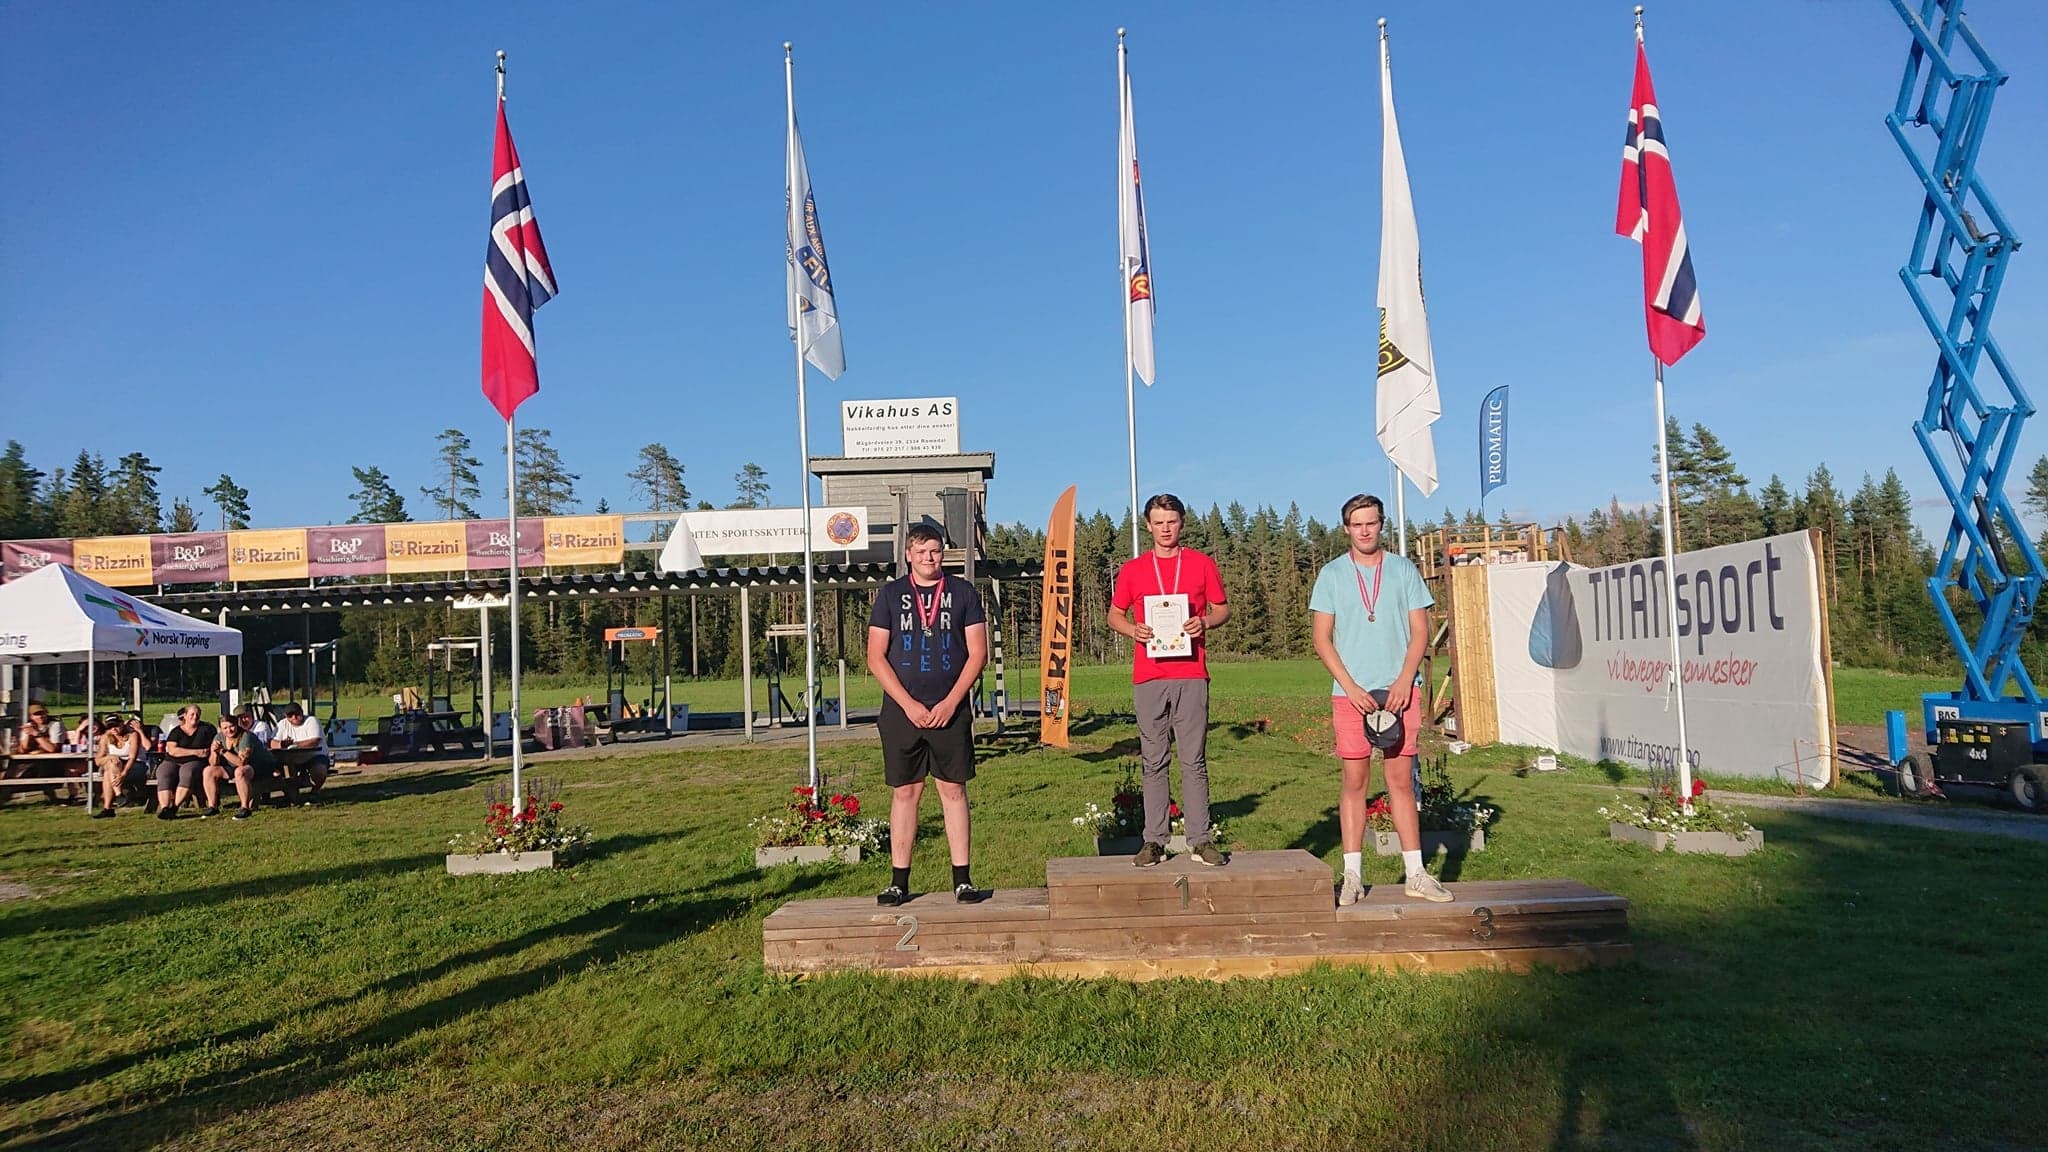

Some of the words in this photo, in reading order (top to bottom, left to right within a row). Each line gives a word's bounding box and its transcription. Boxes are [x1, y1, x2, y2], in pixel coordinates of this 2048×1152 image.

[847, 405, 920, 419] Vikahus
[928, 403, 952, 416] AS
[1489, 400, 1503, 484] PROMATIC
[330, 537, 362, 554] B&P
[407, 540, 459, 555] Rizzini
[565, 533, 617, 548] Rizzini
[95, 554, 145, 570] Rizzini
[174, 545, 205, 562] B&P
[249, 547, 300, 563] Rizzini
[1048, 549, 1069, 678] Rizzini
[153, 631, 178, 645] Norsk
[180, 632, 210, 649] Tipping
[1677, 650, 1758, 686] ennesker
[1969, 748, 1988, 761] 4x4
[1173, 873, 1191, 910] 1
[1471, 906, 1497, 941] 3
[895, 914, 920, 951] 2
